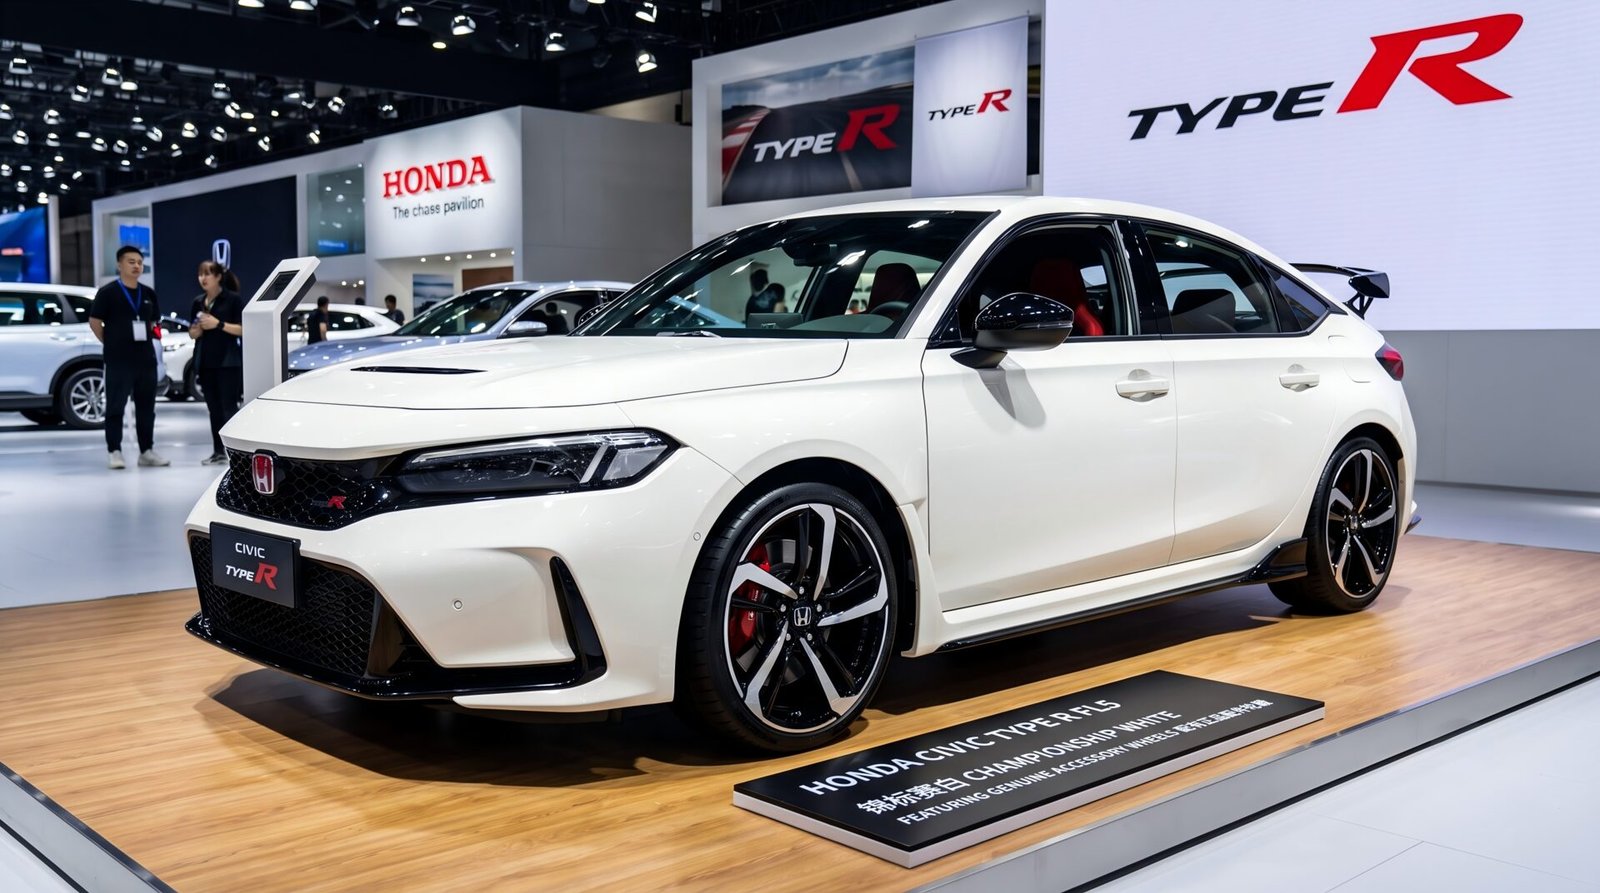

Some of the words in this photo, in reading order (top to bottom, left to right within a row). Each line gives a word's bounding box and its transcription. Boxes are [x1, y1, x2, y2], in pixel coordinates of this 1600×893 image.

[1128, 81, 1334, 140] TYPE
[1337, 13, 1524, 114] R
[928, 103, 976, 121] TYPE
[976, 89, 1012, 114] R
[753, 131, 836, 163] TYPE
[837, 104, 901, 152] R
[383, 155, 491, 198] HONDA
[393, 206, 409, 220] The
[444, 197, 484, 216] pavilion
[225, 564, 255, 582] TYPE
[254, 562, 279, 590] R
[235, 542, 266, 559] CIVIC
[799, 758, 925, 796] HONDA
[915, 736, 996, 762] CIVIC
[984, 717, 1061, 740] TYPE
[1049, 710, 1083, 722] R
[1068, 699, 1122, 717] FL5
[856, 776, 970, 815] 锦标赛白
[962, 728, 1119, 781] CHAMPIONSHIP
[1115, 710, 1183, 732] WHITE
[896, 791, 990, 825] FEATURING
[986, 769, 1057, 795] GENUINE
[1051, 745, 1130, 775] ACCESSORY
[1125, 729, 1180, 750] WHEELS
